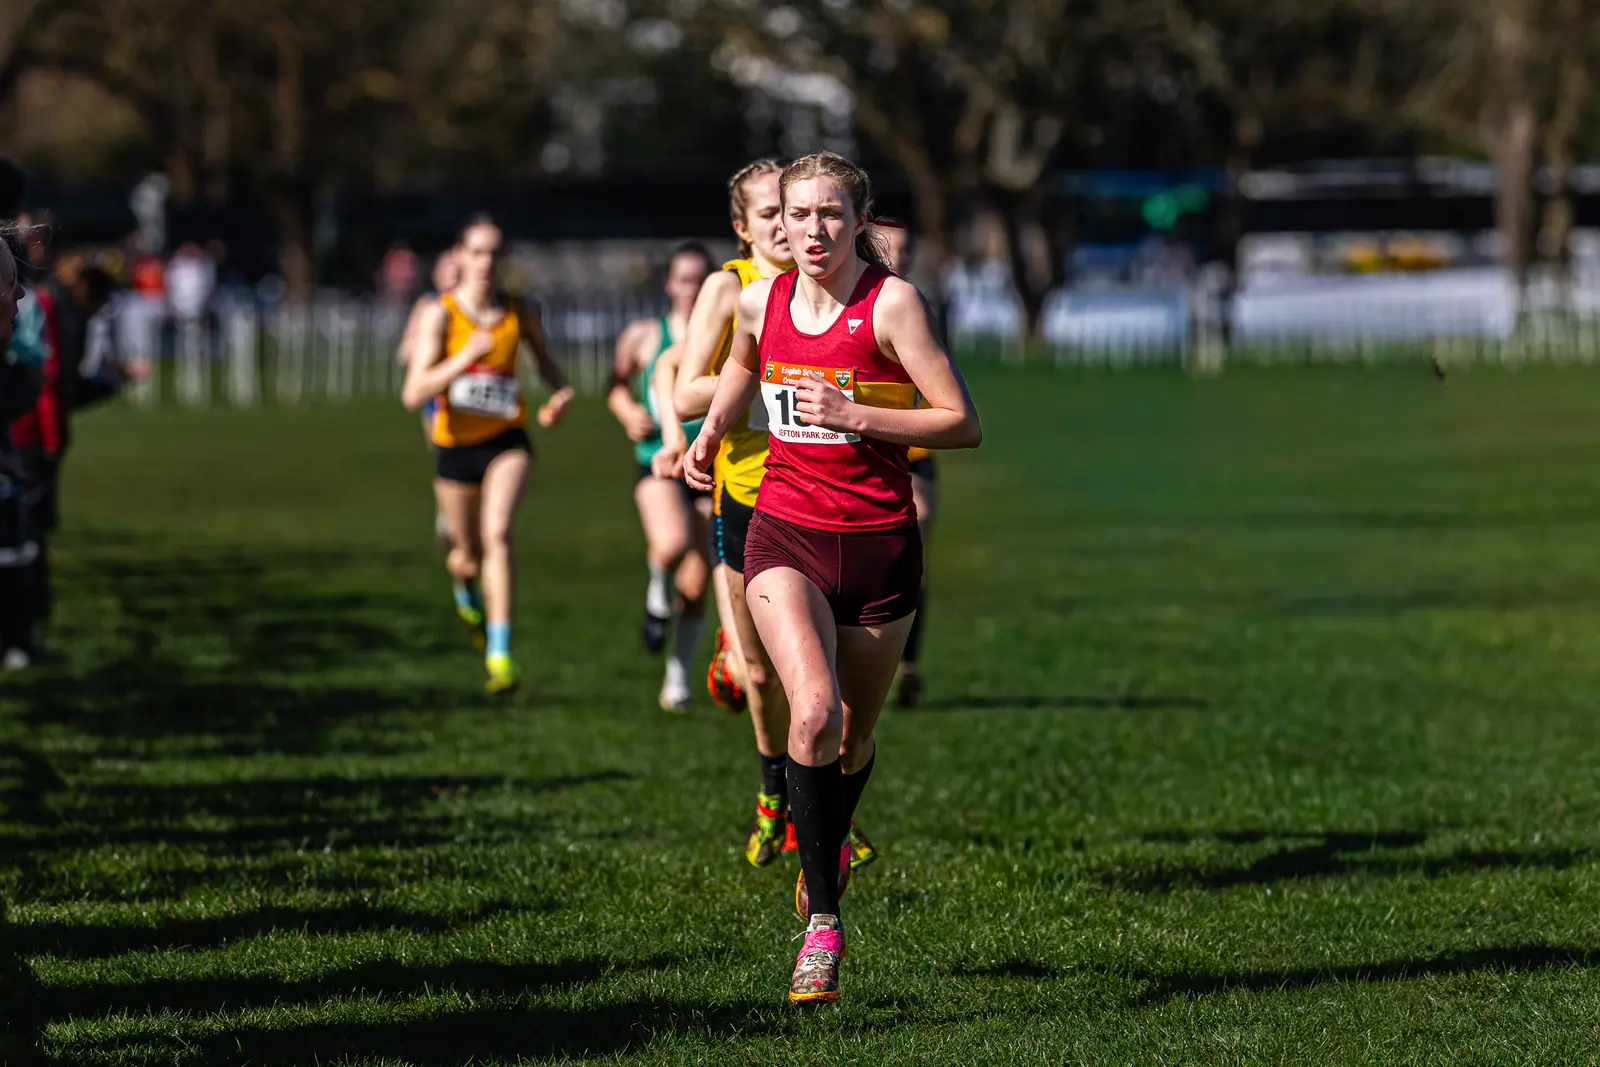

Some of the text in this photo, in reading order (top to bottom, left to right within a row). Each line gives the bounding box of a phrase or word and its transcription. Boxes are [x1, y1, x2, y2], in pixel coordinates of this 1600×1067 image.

[781, 366, 801, 376] English
[801, 431, 820, 439] PARK
[821, 432, 839, 440] 2026
